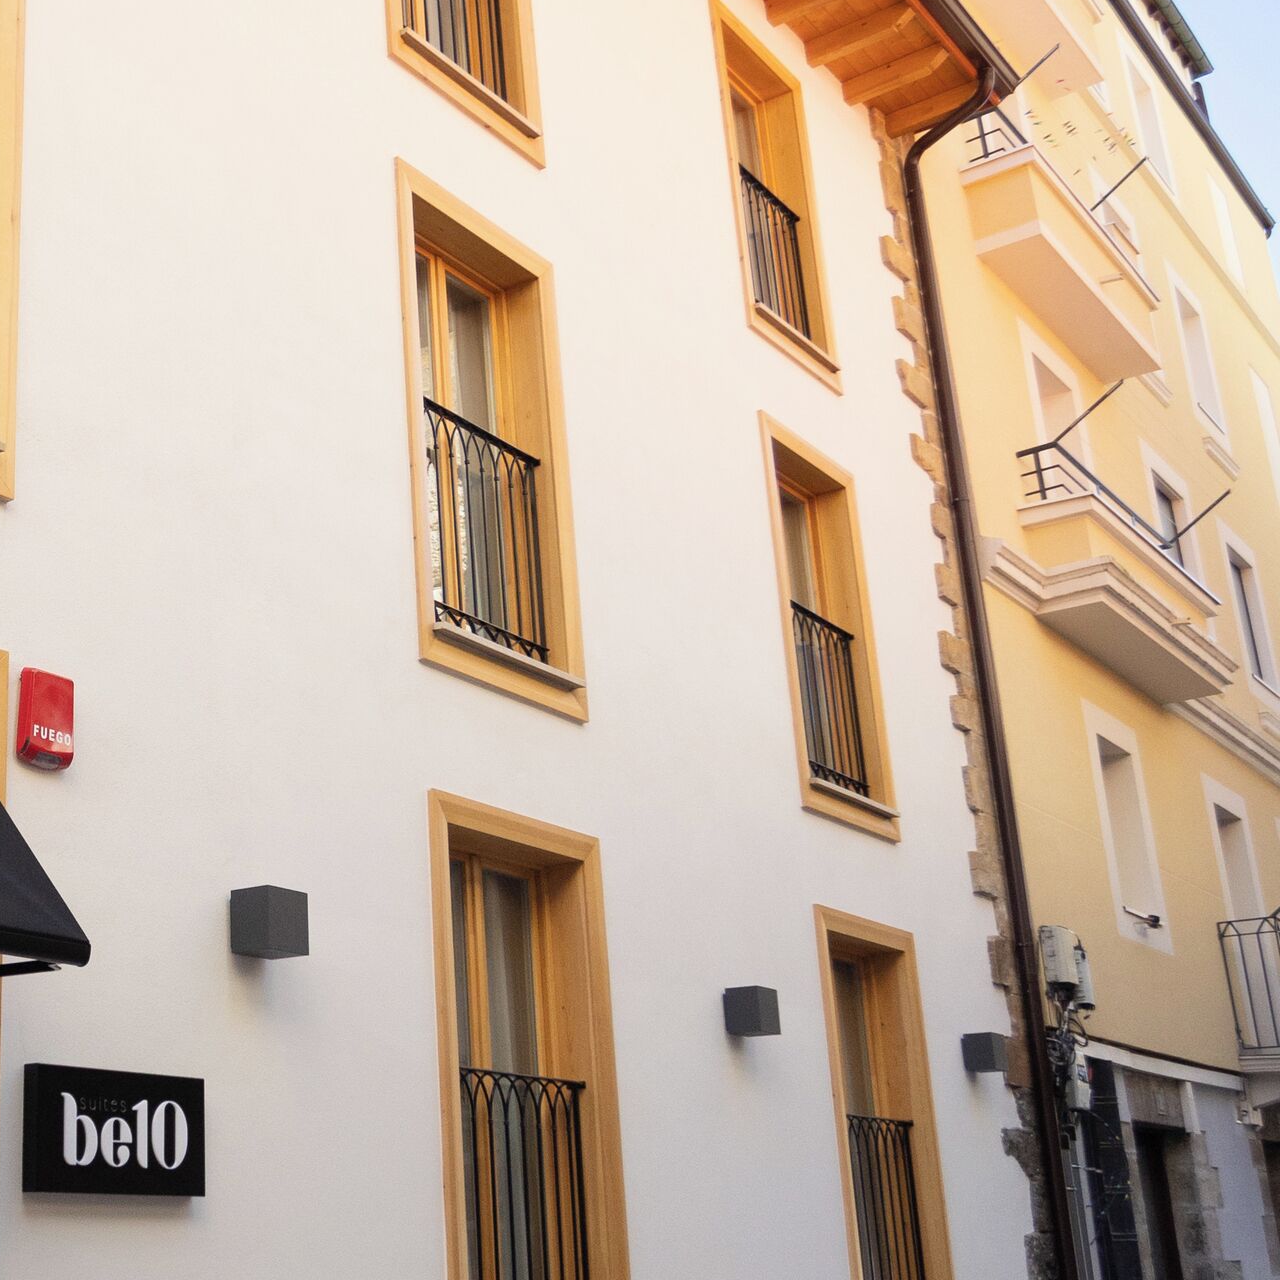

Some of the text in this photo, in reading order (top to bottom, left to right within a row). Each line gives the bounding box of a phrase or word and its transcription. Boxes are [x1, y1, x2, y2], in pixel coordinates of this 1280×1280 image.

[33, 724, 72, 746] FUEGO
[79, 1096, 128, 1113] suites
[60, 1091, 189, 1170] be10
